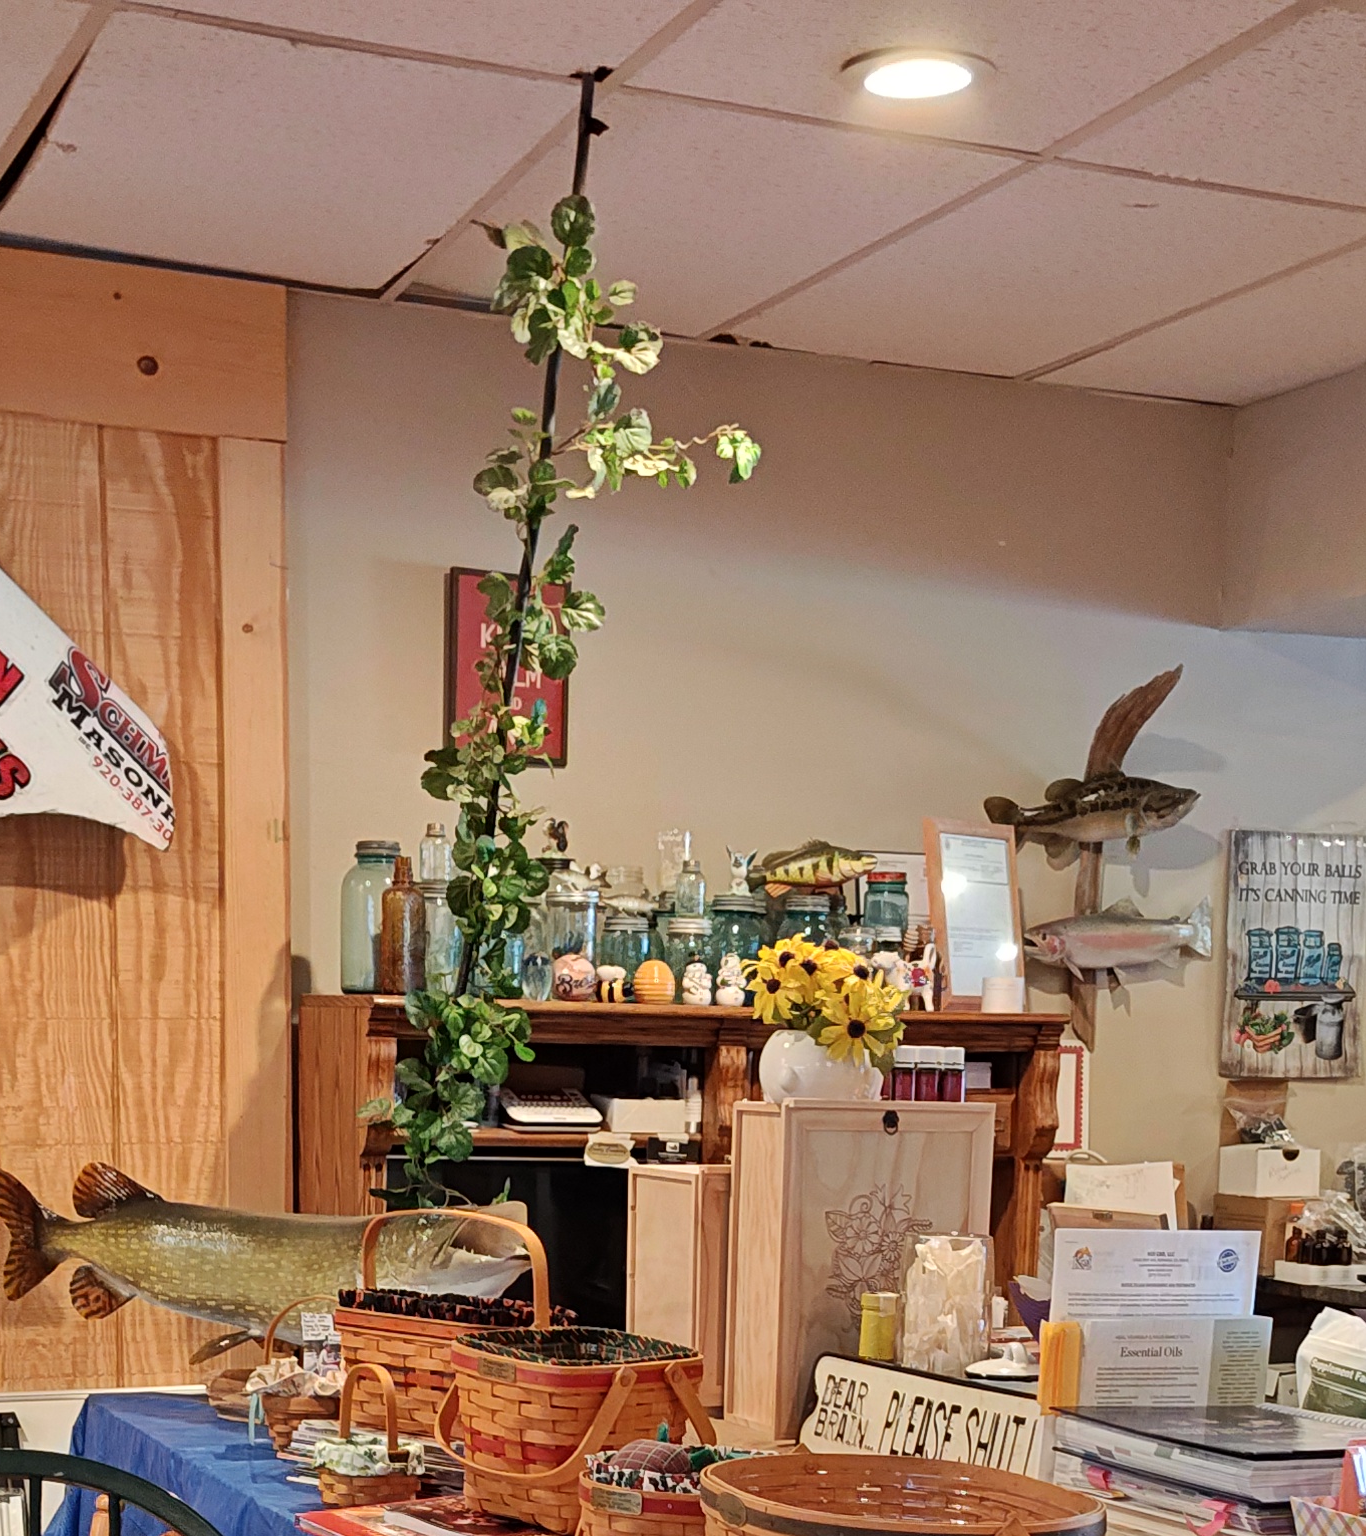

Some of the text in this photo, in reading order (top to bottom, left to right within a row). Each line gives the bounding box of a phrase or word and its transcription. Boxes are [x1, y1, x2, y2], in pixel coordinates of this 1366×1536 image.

[1238, 860, 1363, 879] GRAB YOUR BALLS
[1238, 887, 1362, 905] IT'S CANNING TIME
[1120, 1346, 1183, 1358] Essential Oils
[1311, 1357, 1355, 1380] Supplement
[821, 1374, 869, 1417] DEAR
[877, 1389, 1027, 1476] PLEASE SHUT
